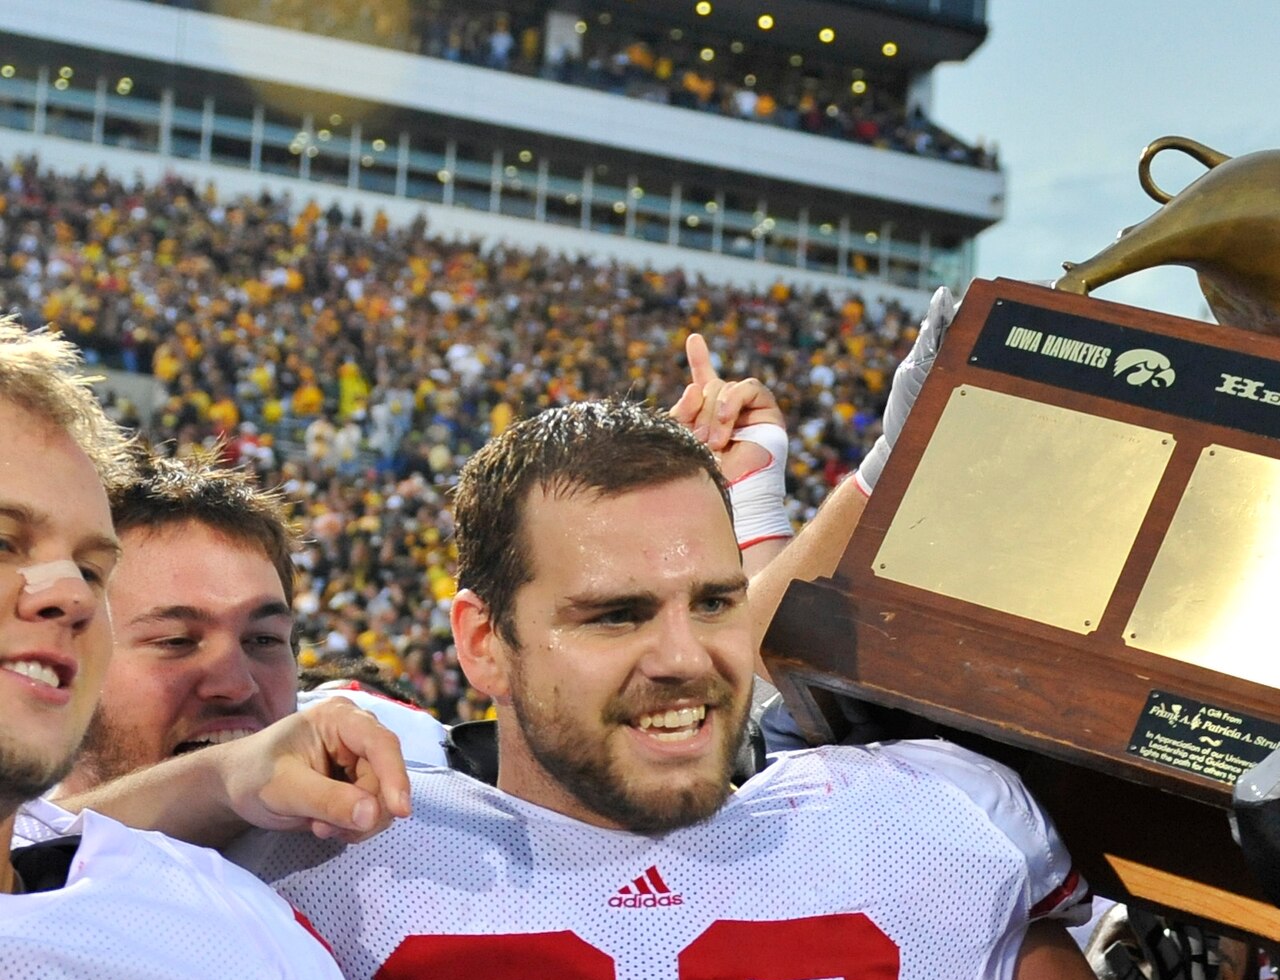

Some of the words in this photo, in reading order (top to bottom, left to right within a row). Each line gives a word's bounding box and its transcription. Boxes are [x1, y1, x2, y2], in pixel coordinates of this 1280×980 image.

[1005, 325, 1044, 355] IOWA
[1041, 335, 1112, 369] HAWKEYES
[1199, 706, 1207, 715] A
[1207, 708, 1222, 719] Gift
[1222, 712, 1242, 725] From
[1153, 731, 1201, 753] Appreciation
[1201, 745, 1211, 755] of
[1210, 749, 1225, 760] our
[1201, 720, 1242, 740] Patricia
[1240, 732, 1253, 744] A.
[1148, 740, 1189, 760] Leadership
[1188, 751, 1204, 763] and
[1205, 756, 1242, 774] Guidance
[1172, 754, 1191, 769] path
[1190, 759, 1203, 771] for
[1203, 764, 1227, 781] others
[607, 893, 684, 908] adidas
